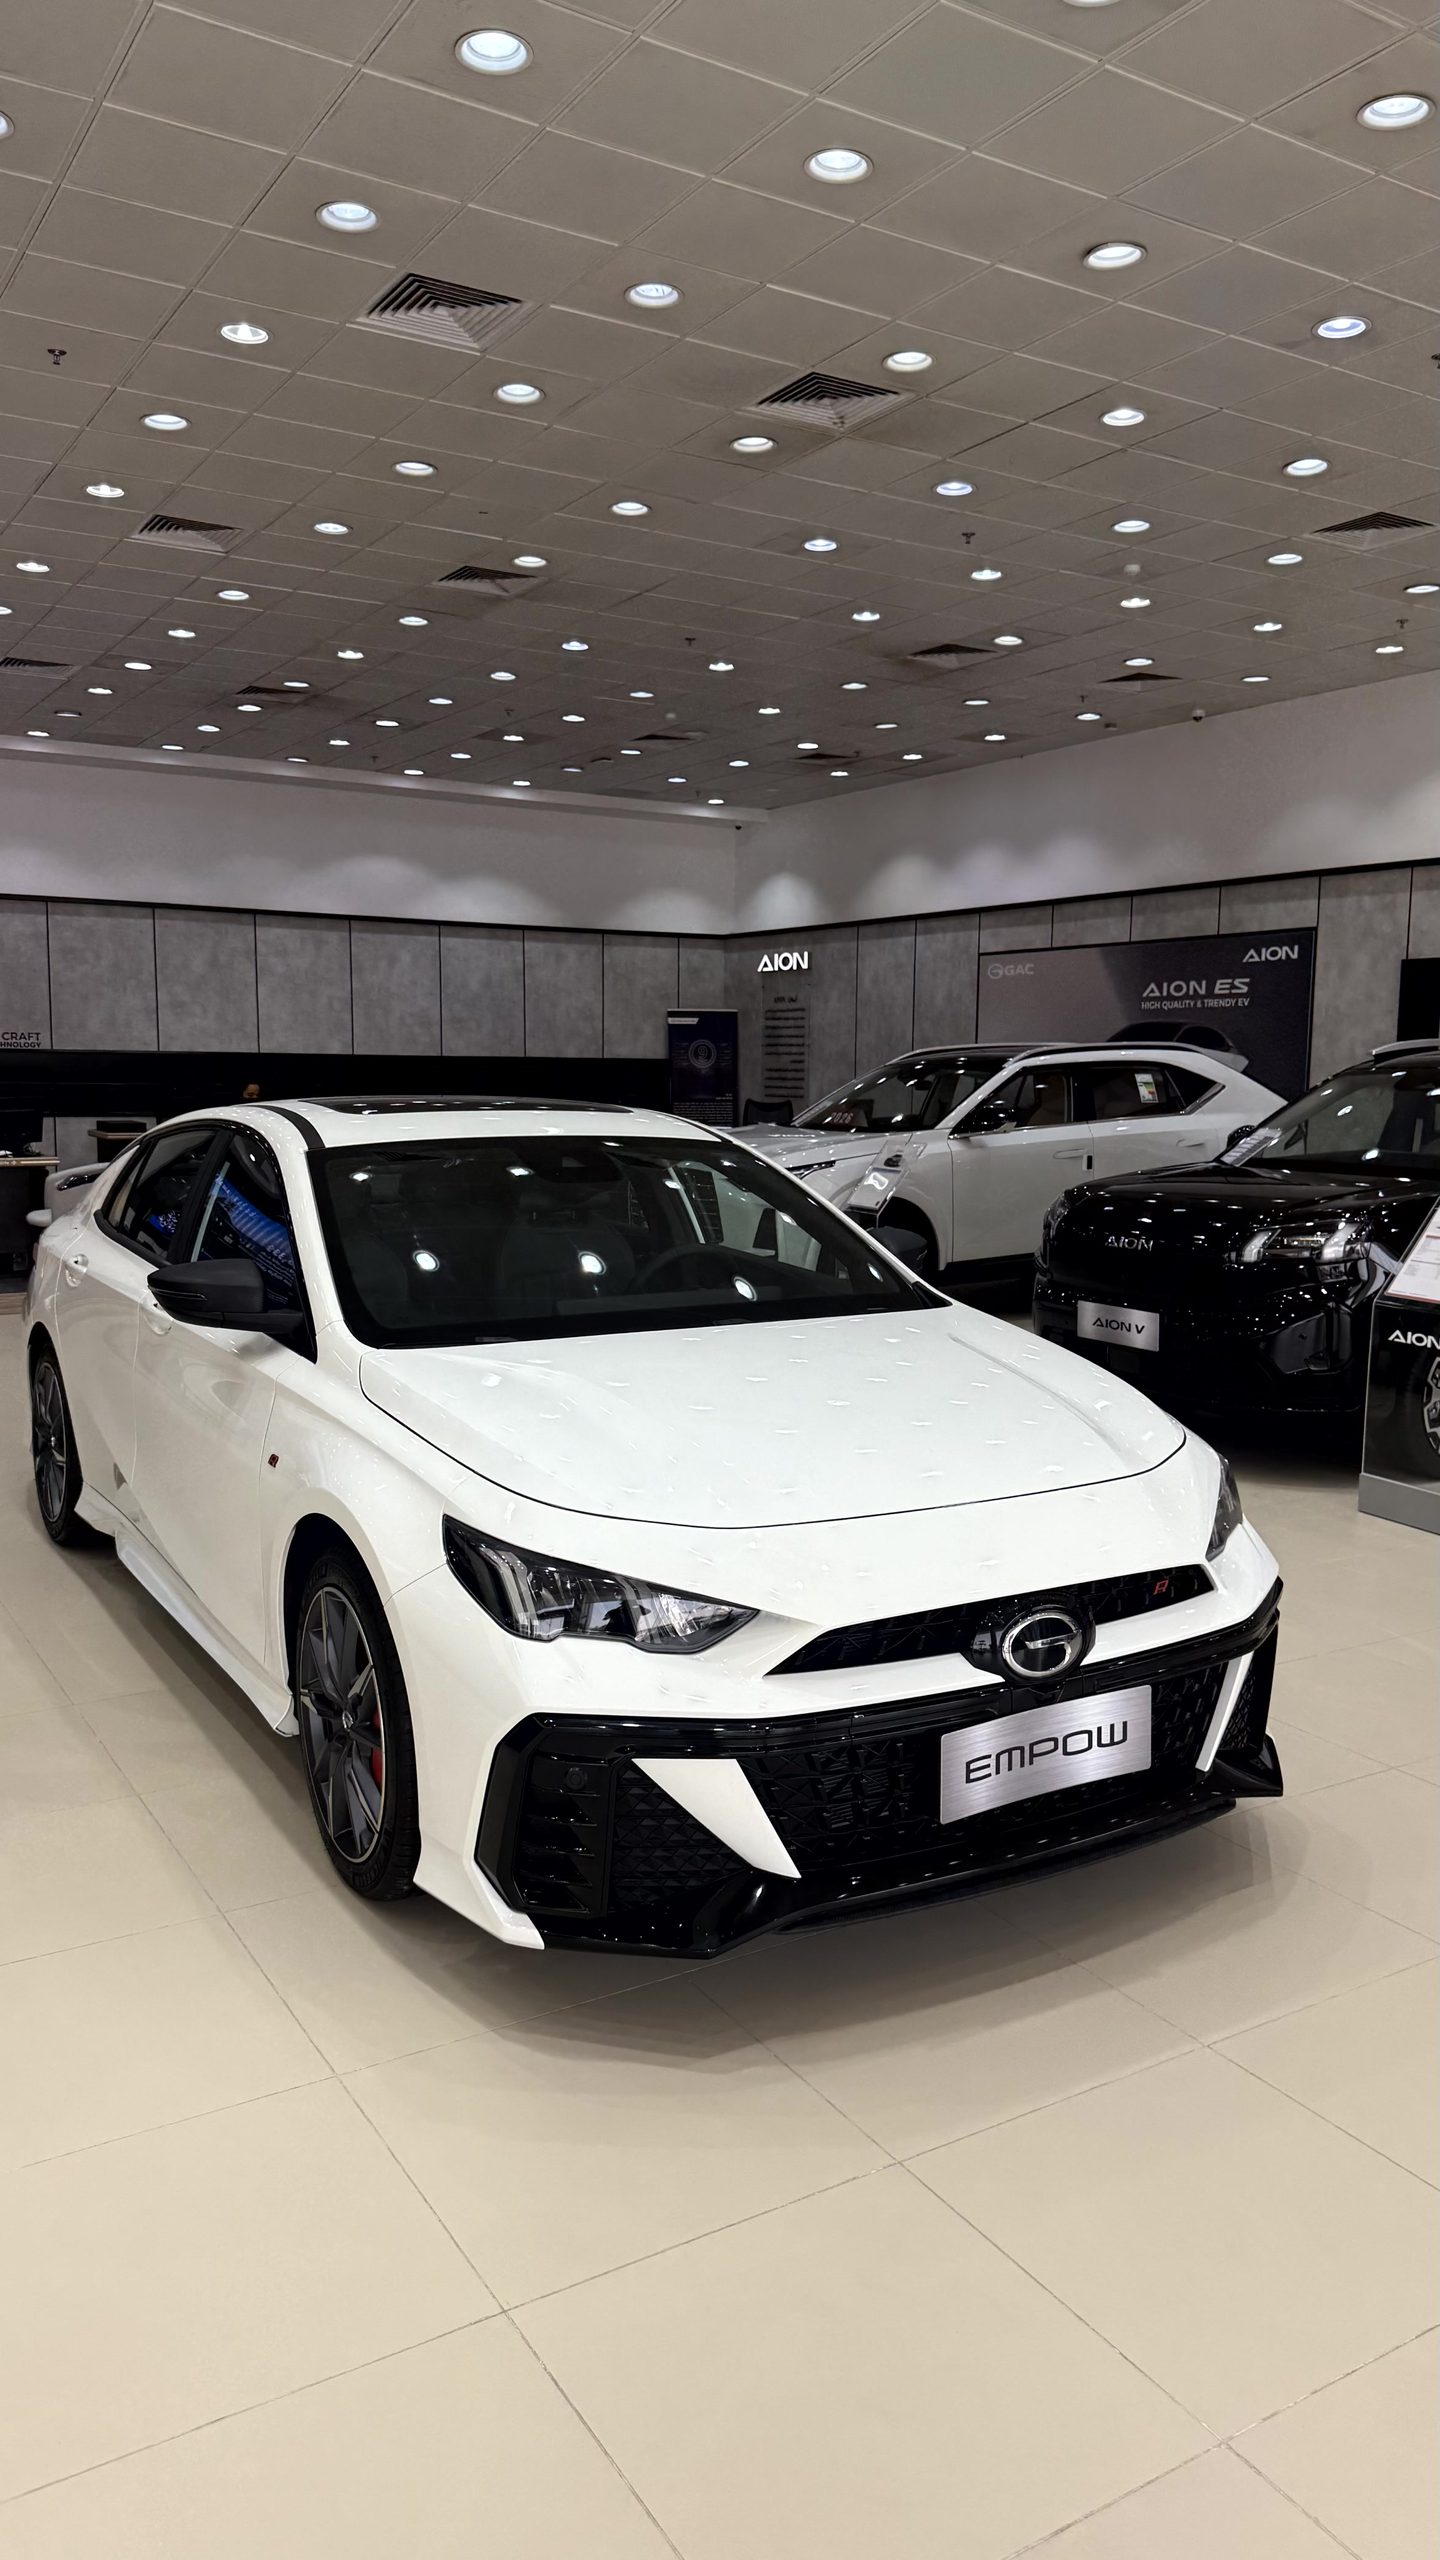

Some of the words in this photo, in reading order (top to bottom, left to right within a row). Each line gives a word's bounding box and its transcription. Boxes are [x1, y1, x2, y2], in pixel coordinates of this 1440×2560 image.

[757, 951, 809, 972] AION
[1242, 945, 1299, 963] AION
[1004, 963, 1035, 976] GAC
[1142, 980, 1206, 997] AION
[1214, 978, 1250, 994] ES
[1141, 1001, 1161, 1010] HIGH
[1162, 1000, 1194, 1010] QUALITY
[1204, 998, 1236, 1007] TRENDY
[1238, 998, 1249, 1006] EV
[1, 1031, 41, 1041] CRAFT
[1105, 1236, 1154, 1251] AION
[1092, 1317, 1132, 1333] AION
[1135, 1324, 1145, 1334] V
[1387, 1329, 1440, 1350] AION
[965, 1720, 1128, 1785] EMPOW
